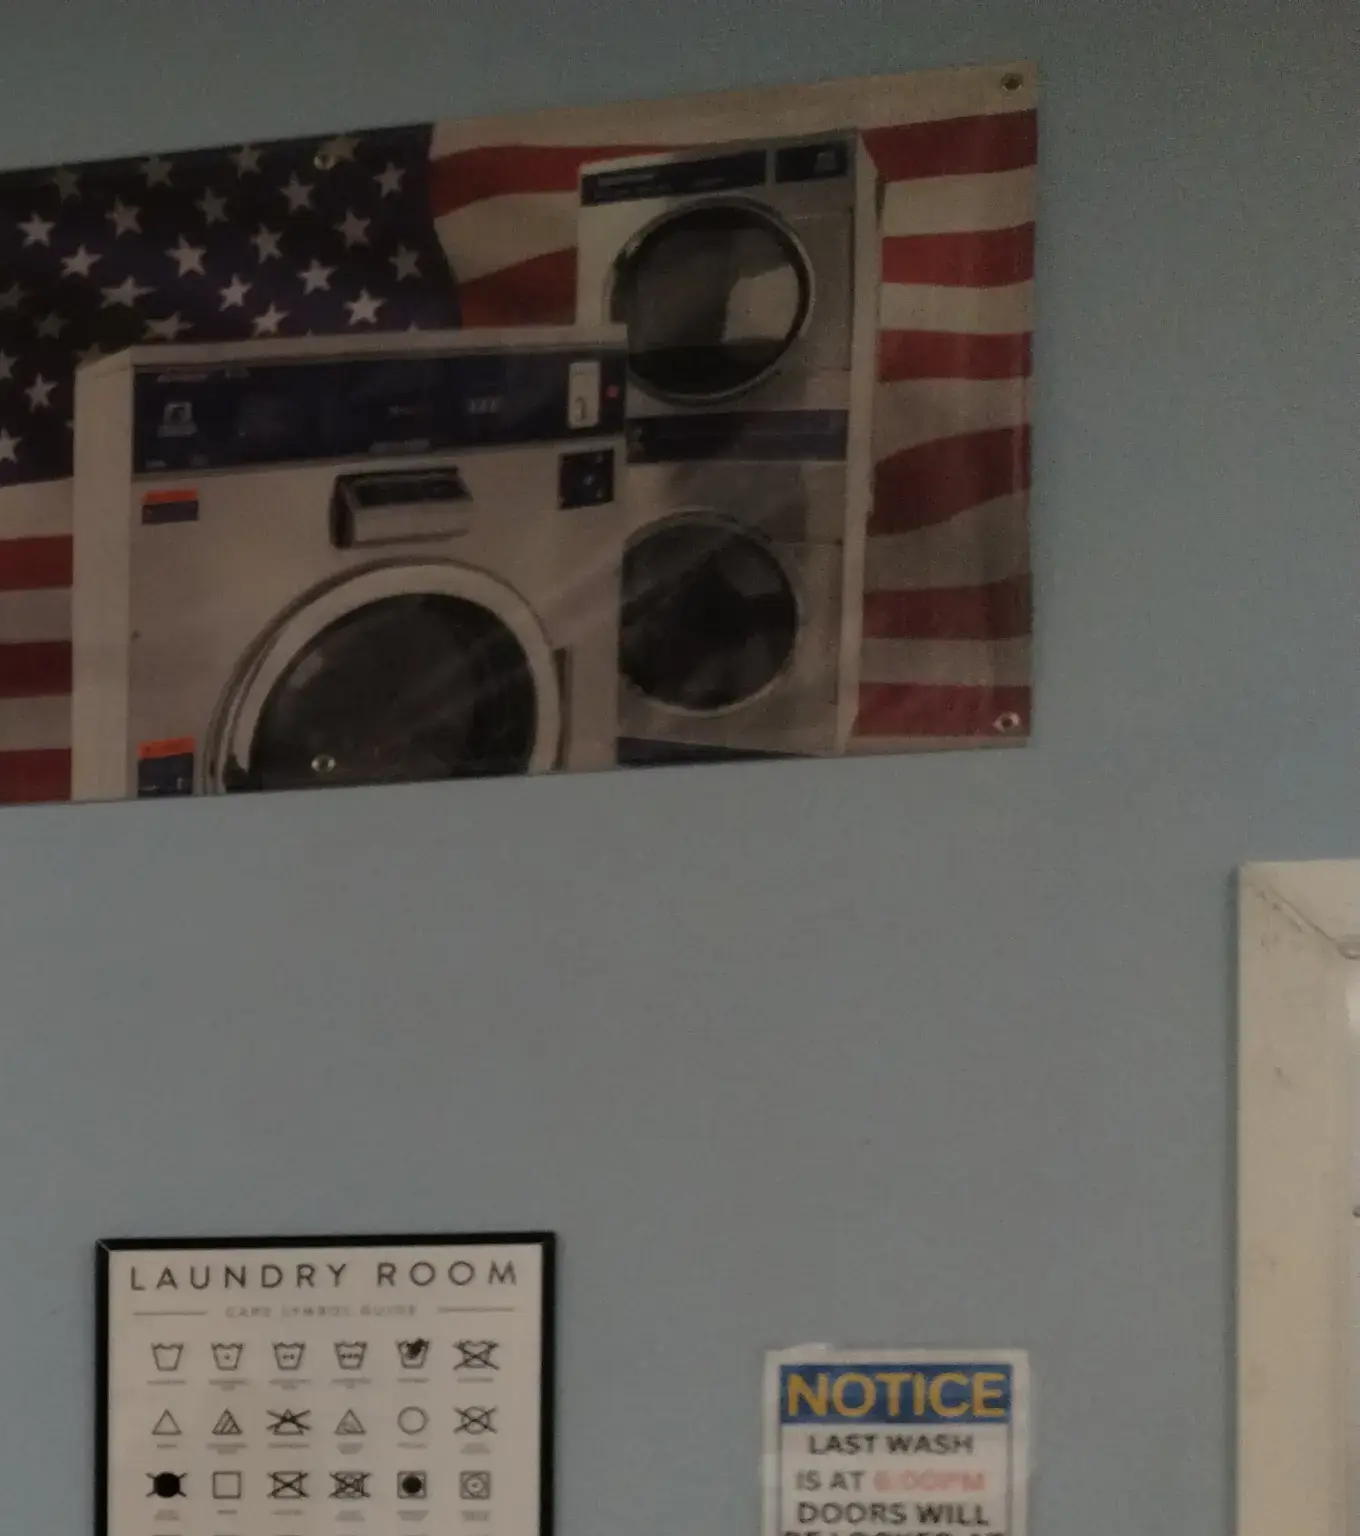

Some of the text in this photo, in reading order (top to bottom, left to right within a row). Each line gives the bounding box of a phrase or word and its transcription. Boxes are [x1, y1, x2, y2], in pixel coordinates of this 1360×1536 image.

[130, 1259, 517, 1292] LAUNDRY ROOM
[786, 1372, 1006, 1418] NOTICE
[809, 1433, 975, 1457] LAST WASH
[794, 1469, 822, 1492] IS
[829, 1469, 866, 1491] AT
[796, 1501, 990, 1527] DOORS WILL
